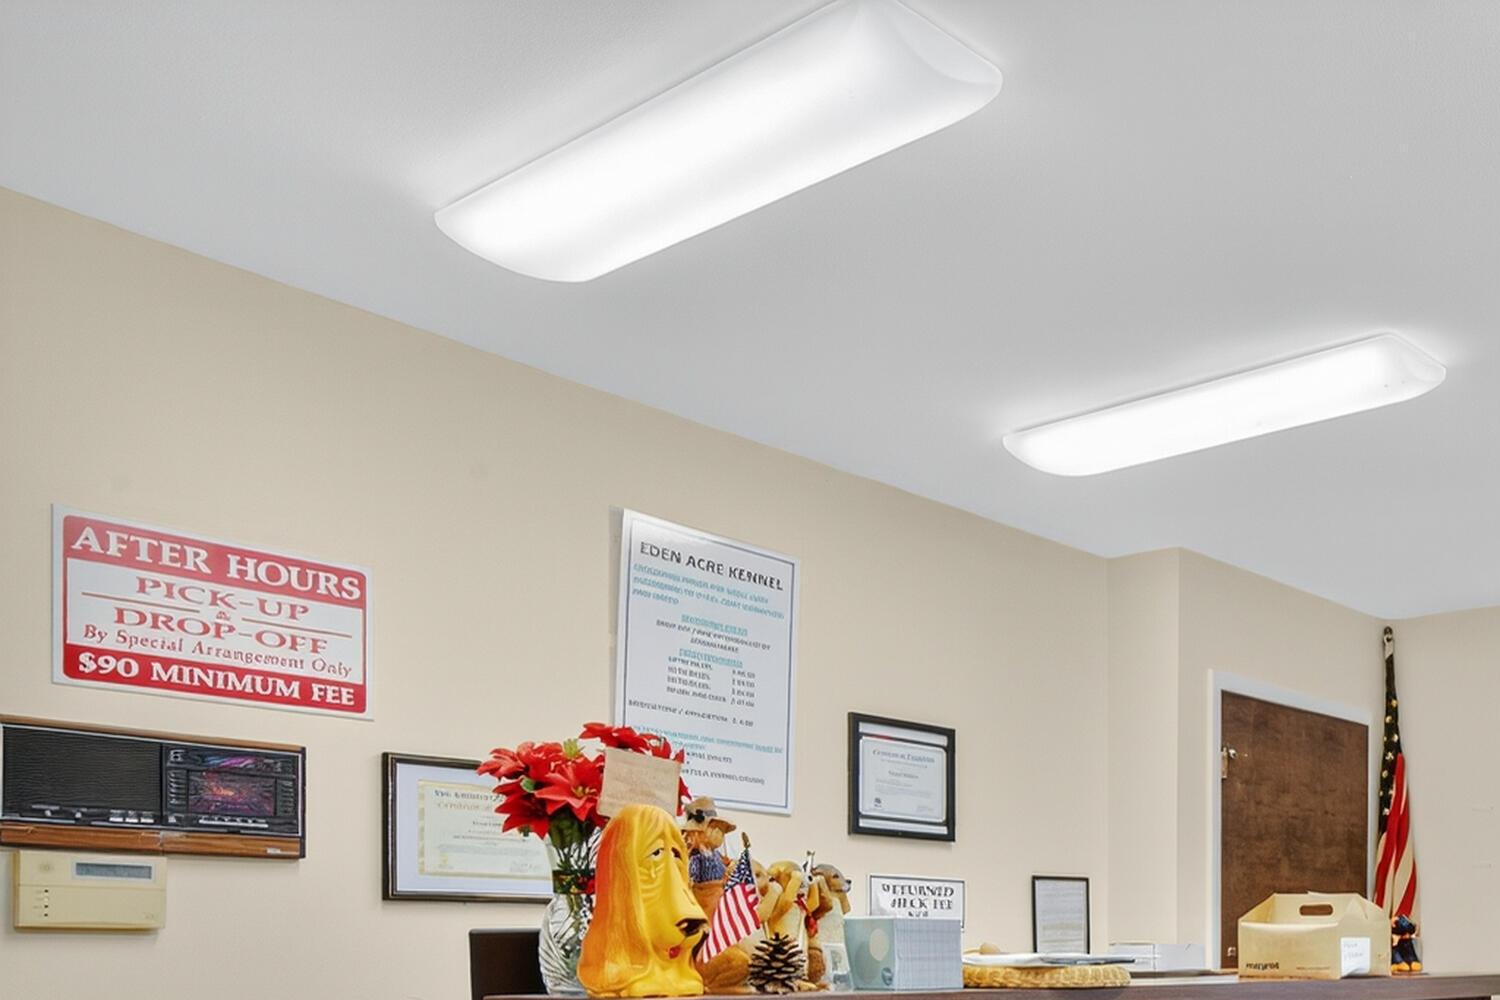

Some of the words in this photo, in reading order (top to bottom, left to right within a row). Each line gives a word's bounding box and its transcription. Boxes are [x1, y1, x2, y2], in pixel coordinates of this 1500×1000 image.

[71, 526, 212, 574] AFTER
[227, 554, 361, 600] HOURS
[640, 541, 682, 564] EDEN
[686, 555, 724, 575] ACRE
[728, 566, 783, 591] KENNEL
[136, 576, 309, 620] PICK-UP
[83, 624, 108, 643] By
[116, 629, 184, 651] Special
[192, 641, 304, 669] Arrangement
[312, 657, 352, 678] Only
[114, 607, 328, 654] DROP-OFF
[78, 651, 139, 678] $90
[151, 662, 300, 699] MINIMUM
[311, 683, 355, 705] FEE
